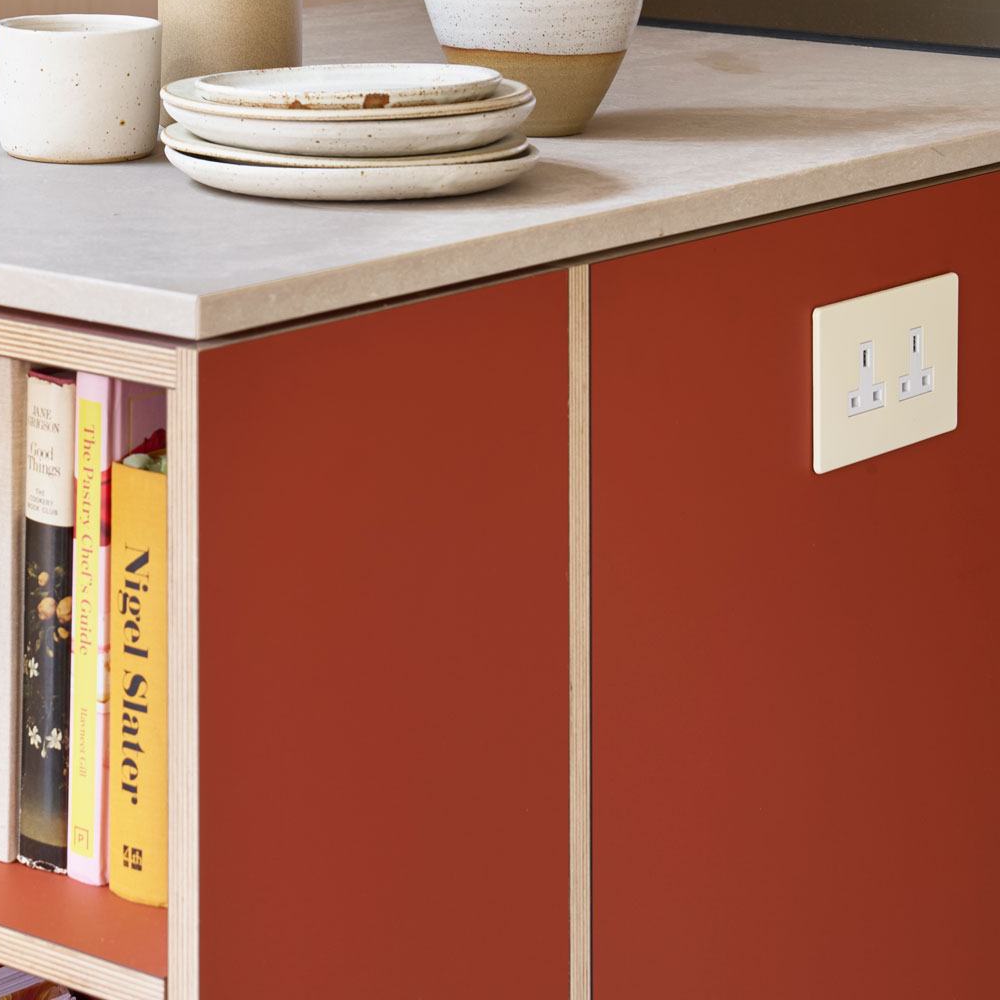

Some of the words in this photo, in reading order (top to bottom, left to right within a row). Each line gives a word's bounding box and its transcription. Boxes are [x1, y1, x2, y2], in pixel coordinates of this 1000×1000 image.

[32, 406, 51, 419] JANE
[28, 455, 60, 477] Things
[30, 441, 54, 460] Good
[83, 425, 95, 460] The
[81, 467, 94, 523] Pastry
[81, 534, 93, 593] Chef's
[80, 599, 91, 656] Guide
[117, 542, 149, 658] Nigel
[121, 671, 148, 805] Slater
